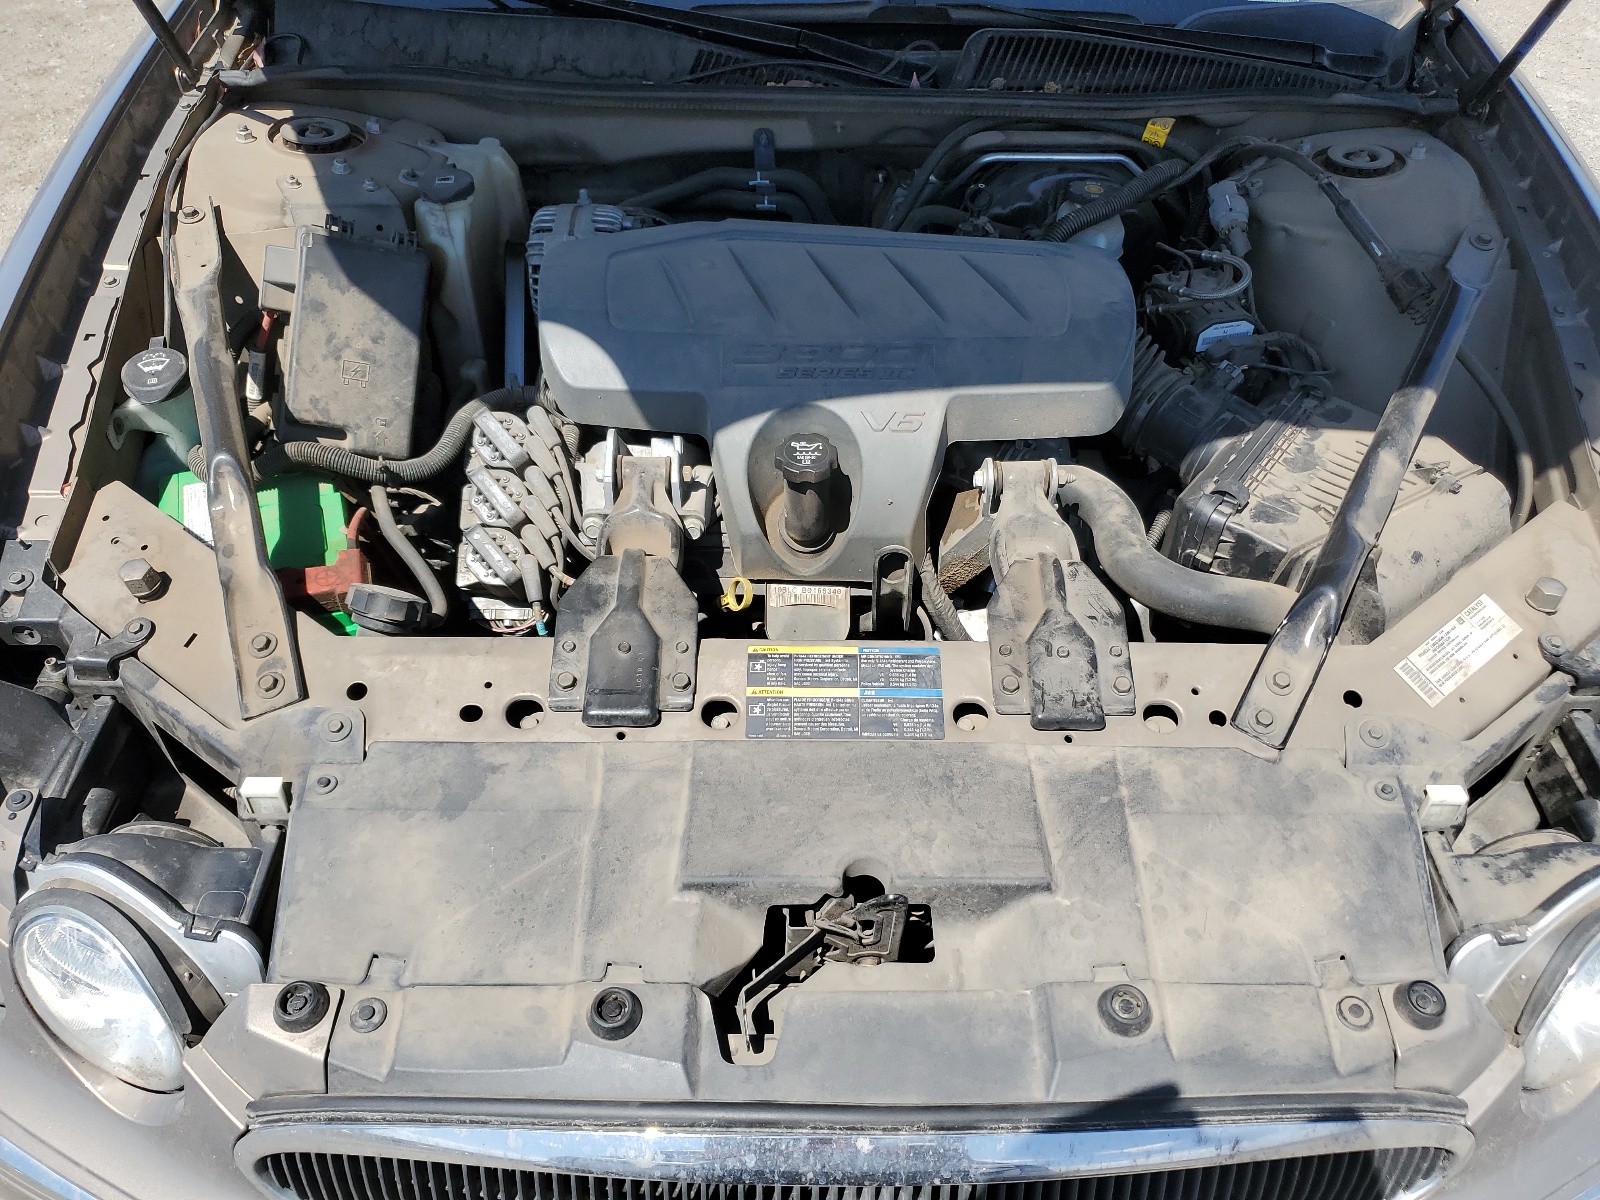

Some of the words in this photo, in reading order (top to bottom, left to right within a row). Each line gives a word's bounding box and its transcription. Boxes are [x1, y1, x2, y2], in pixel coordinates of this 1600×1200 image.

[775, 366, 875, 380] SERIES
[860, 410, 926, 434] V6
[1463, 599, 1484, 617] CATALYST
